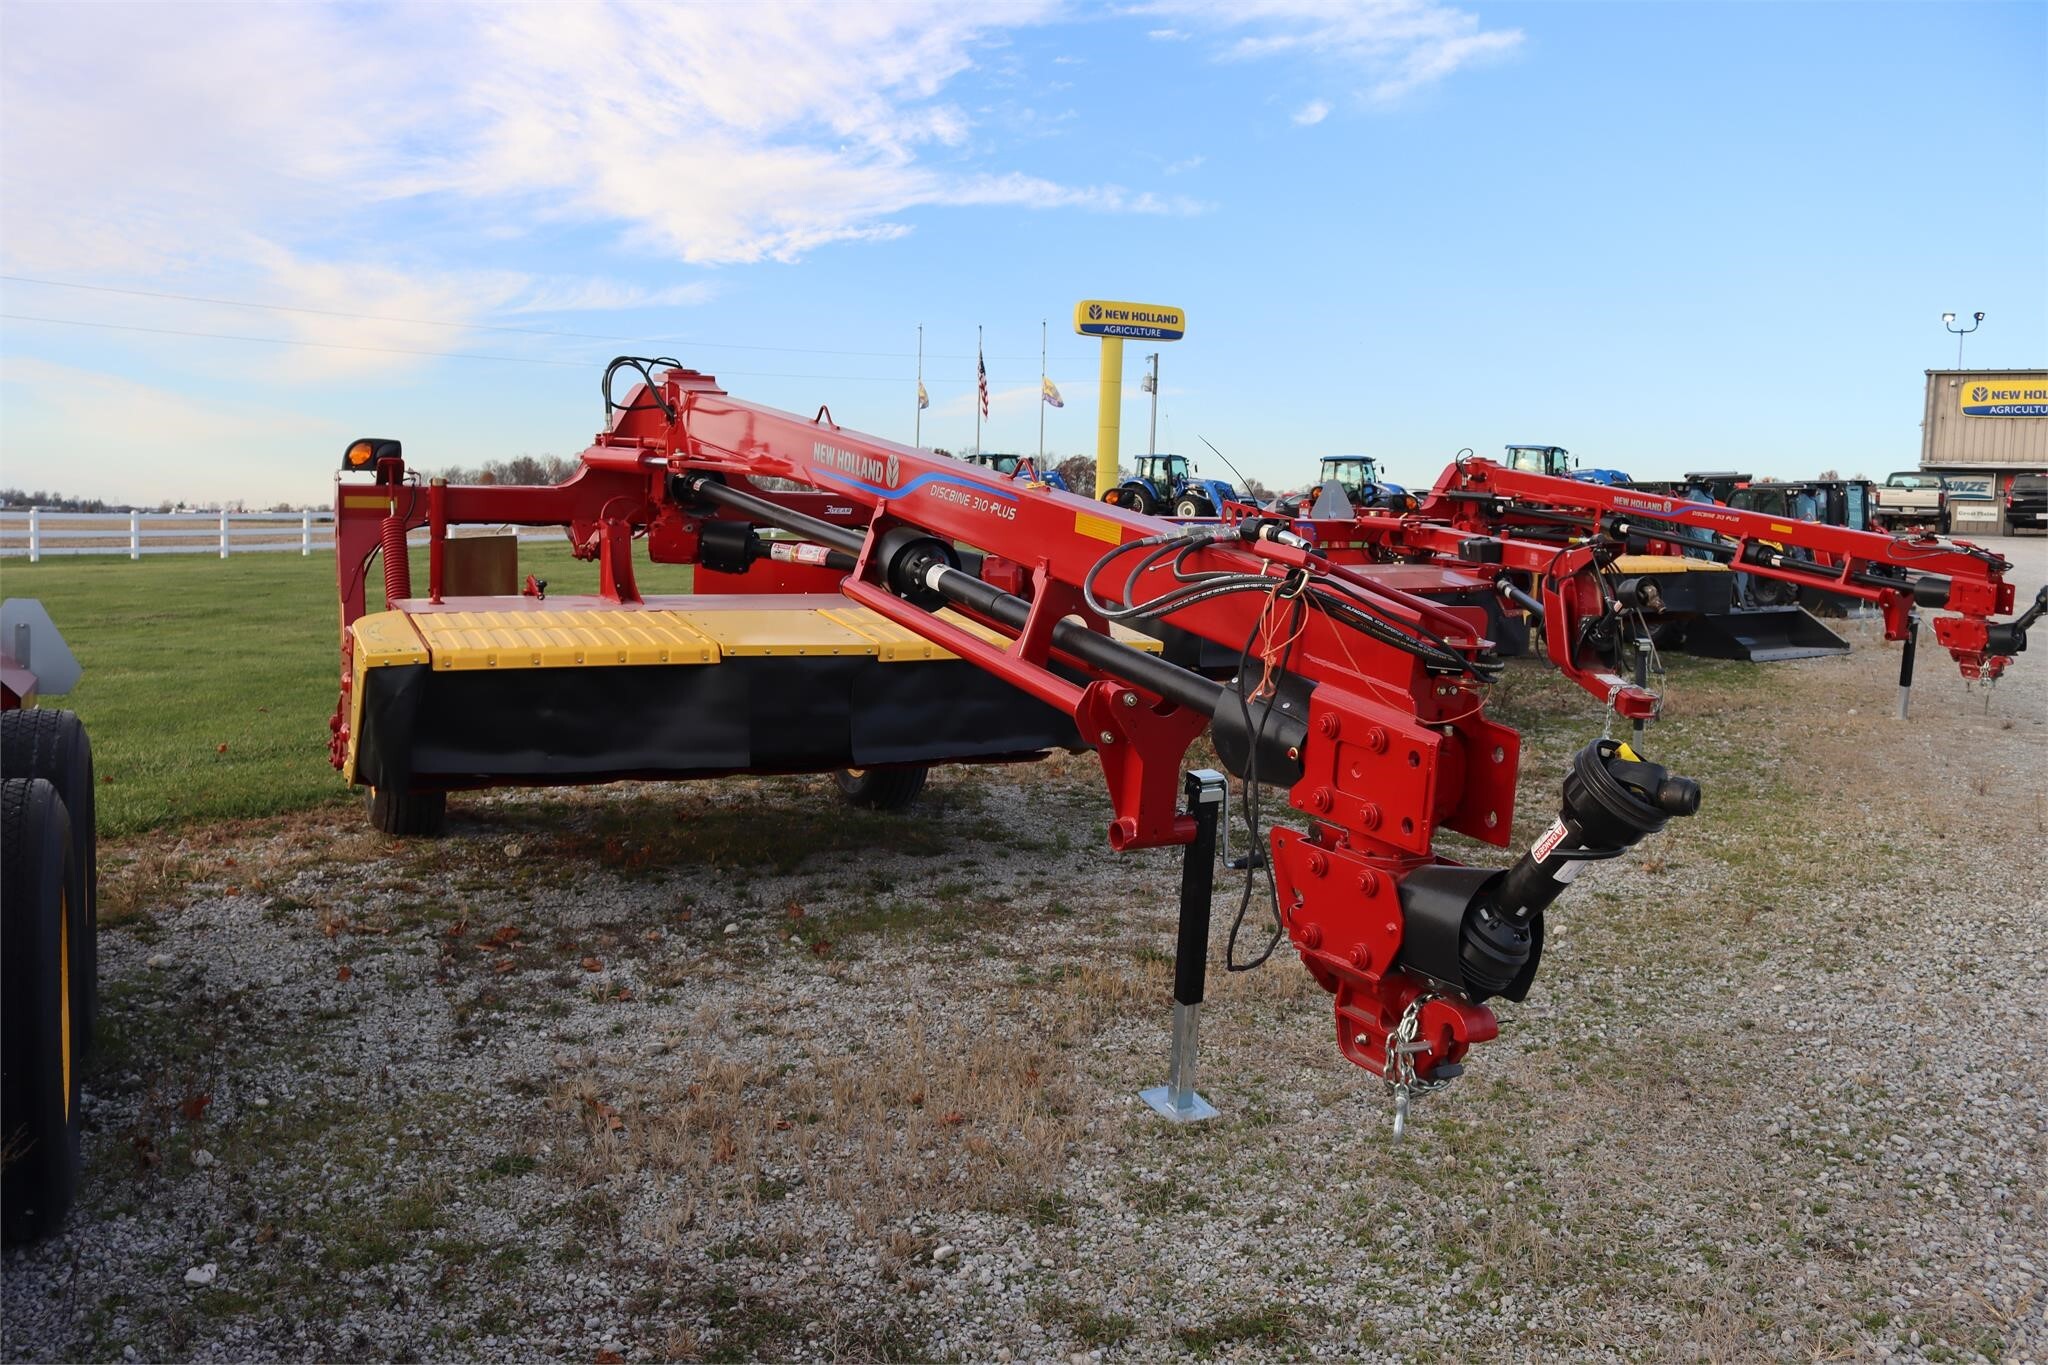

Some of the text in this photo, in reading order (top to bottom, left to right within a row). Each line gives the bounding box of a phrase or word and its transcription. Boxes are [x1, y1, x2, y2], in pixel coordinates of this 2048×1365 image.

[1105, 309, 1178, 324] NEW HOLLAND
[1103, 325, 1161, 336] AGRICULTURE
[1991, 390, 2021, 400] NEW
[813, 442, 884, 483] NEW HOLLAND
[930, 484, 971, 506] DISCBINE
[972, 497, 989, 512] 310
[1613, 496, 1662, 511] NEW HOLLAND
[1534, 831, 1558, 859] DANGER
